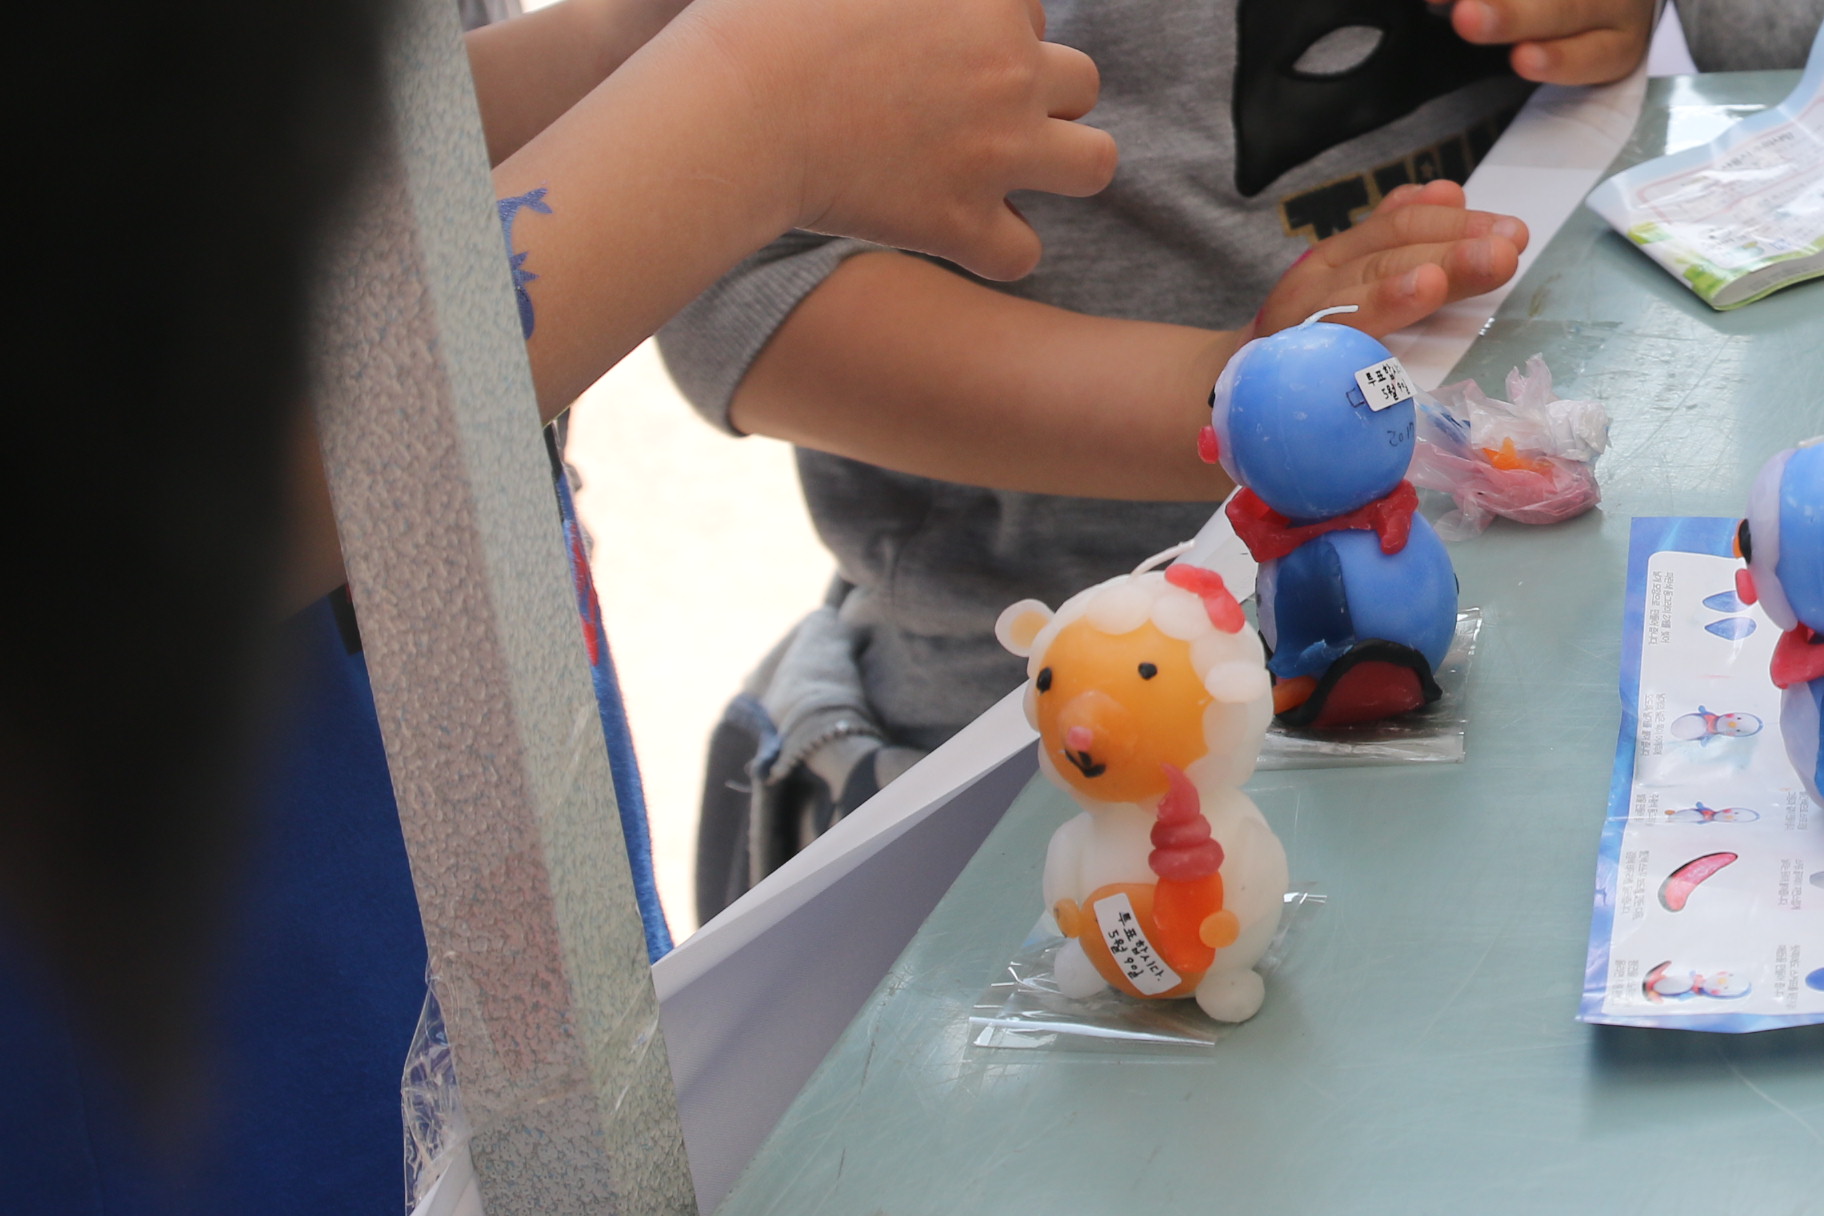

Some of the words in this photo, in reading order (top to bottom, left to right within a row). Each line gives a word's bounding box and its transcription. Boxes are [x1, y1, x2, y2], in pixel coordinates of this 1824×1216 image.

[1108, 929, 1128, 955] 5월
[1124, 957, 1144, 979] 9일
[1118, 911, 1165, 981] 투표합시다.
